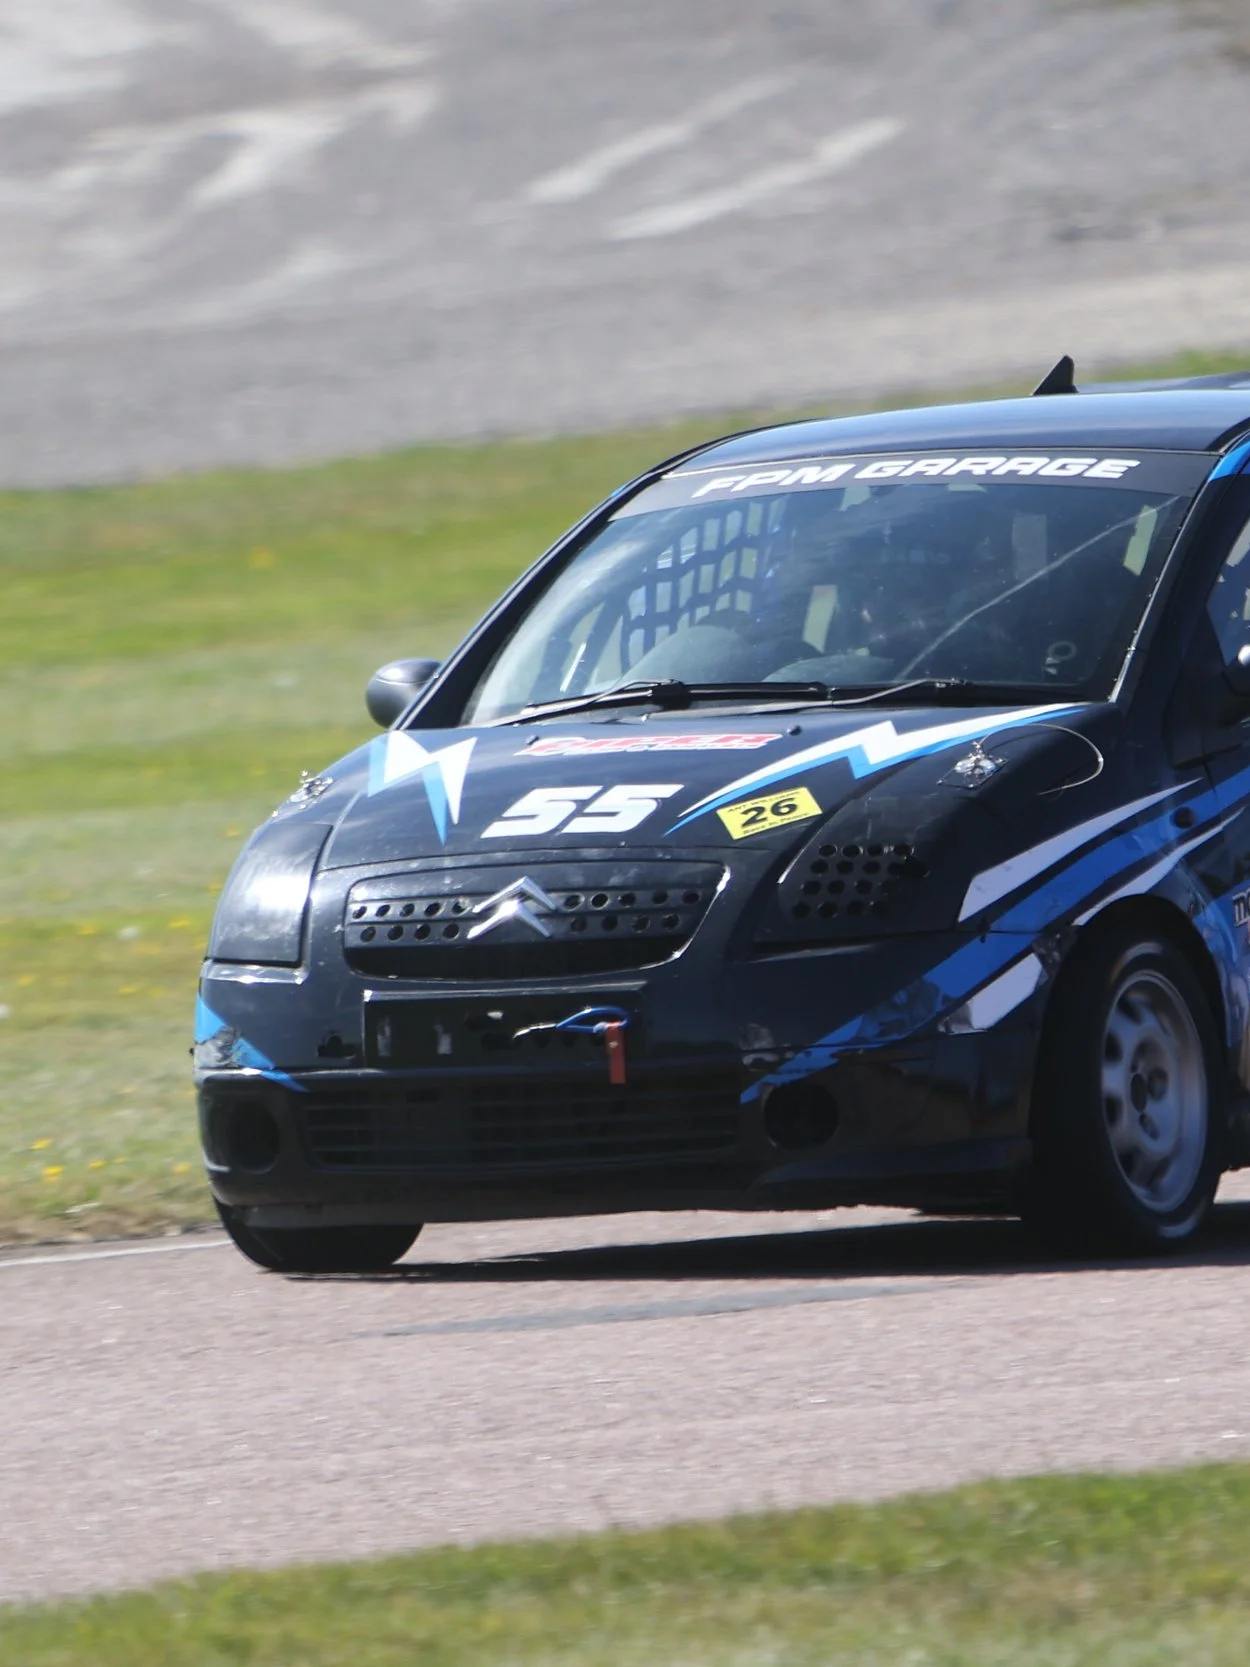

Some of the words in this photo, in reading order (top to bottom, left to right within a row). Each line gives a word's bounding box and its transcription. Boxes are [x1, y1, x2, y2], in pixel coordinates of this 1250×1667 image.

[692, 463, 855, 498] FPM
[853, 456, 1141, 480] GARAGE
[480, 784, 685, 839] 55
[740, 797, 798, 828] 26
